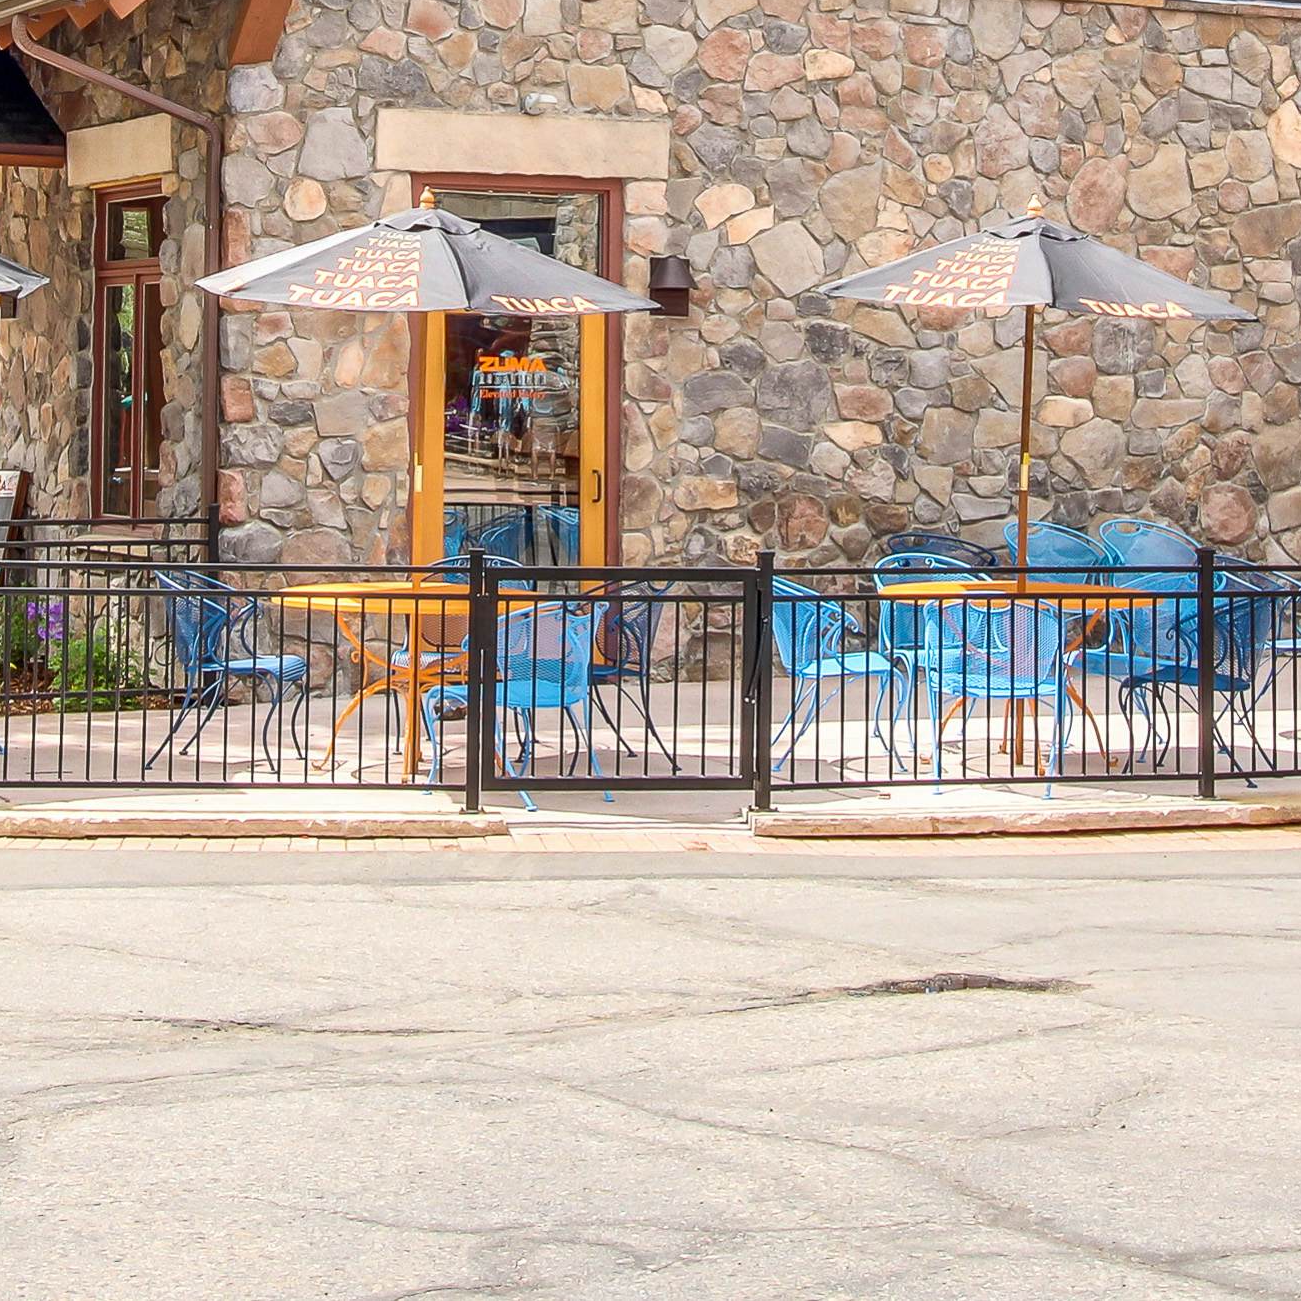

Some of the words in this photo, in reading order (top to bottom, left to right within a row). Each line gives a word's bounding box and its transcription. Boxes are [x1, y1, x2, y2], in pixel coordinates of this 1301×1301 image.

[368, 238, 420, 249] TUACA
[379, 231, 421, 240] TUACA
[354, 246, 420, 260] TUACA
[970, 243, 1020, 252] TUACA
[954, 250, 1016, 263] TUACA
[337, 257, 420, 273] TUACA
[936, 258, 1014, 275] TUACA
[314, 268, 418, 289] TUACA
[912, 269, 1009, 290] TUACA
[289, 283, 419, 307] TUACA
[884, 284, 1005, 307] TUACA
[490, 294, 600, 313] TUACA
[1078, 298, 1193, 319] TUACA
[479, 356, 547, 372] ZUMA
